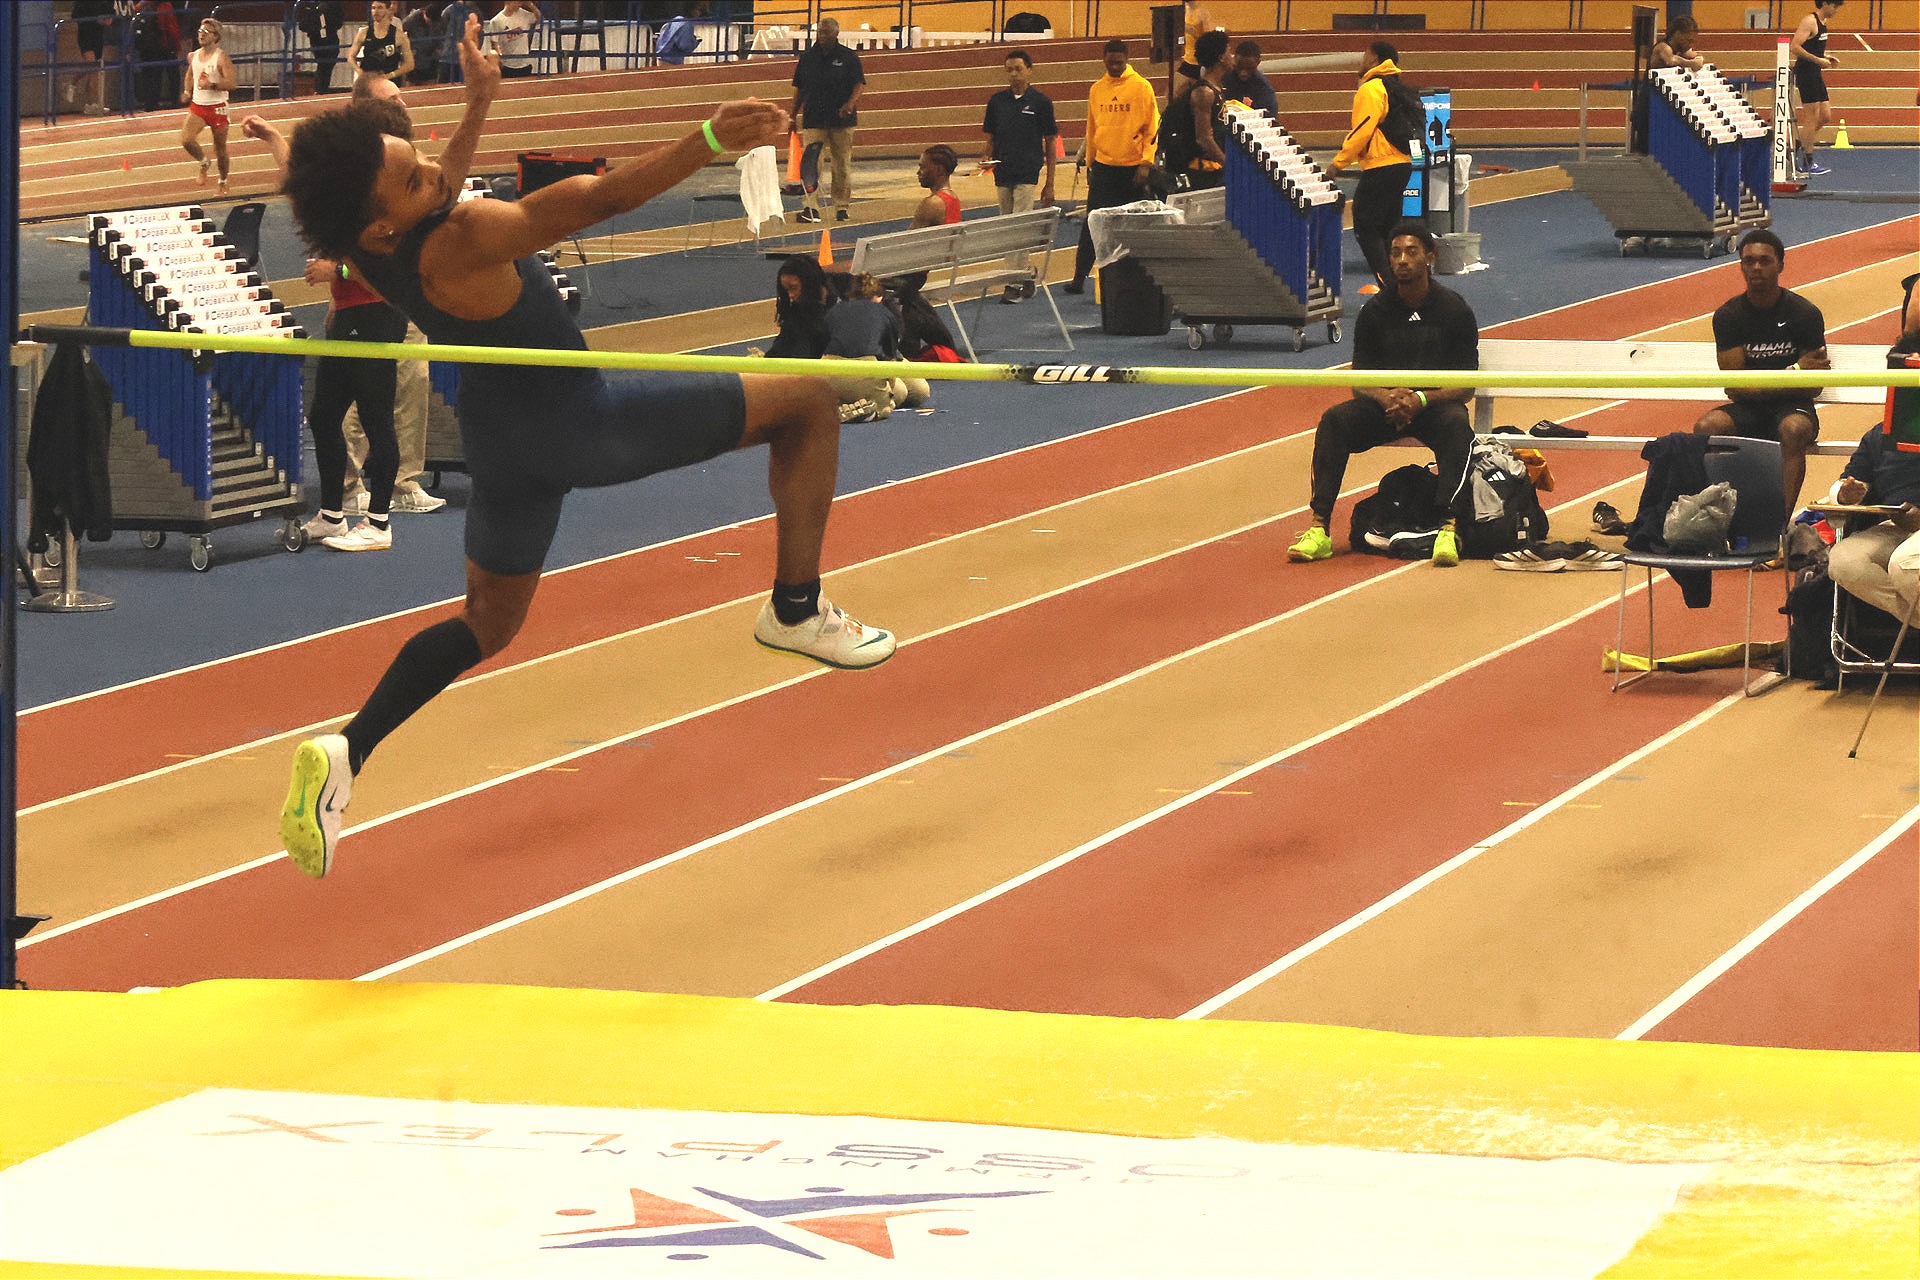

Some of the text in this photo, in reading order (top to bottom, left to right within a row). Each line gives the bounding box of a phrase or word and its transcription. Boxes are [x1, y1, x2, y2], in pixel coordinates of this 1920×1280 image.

[1100, 103, 1131, 112] TIGERS
[1775, 67, 1787, 170] FINISH
[1033, 365, 1110, 382] GILL
